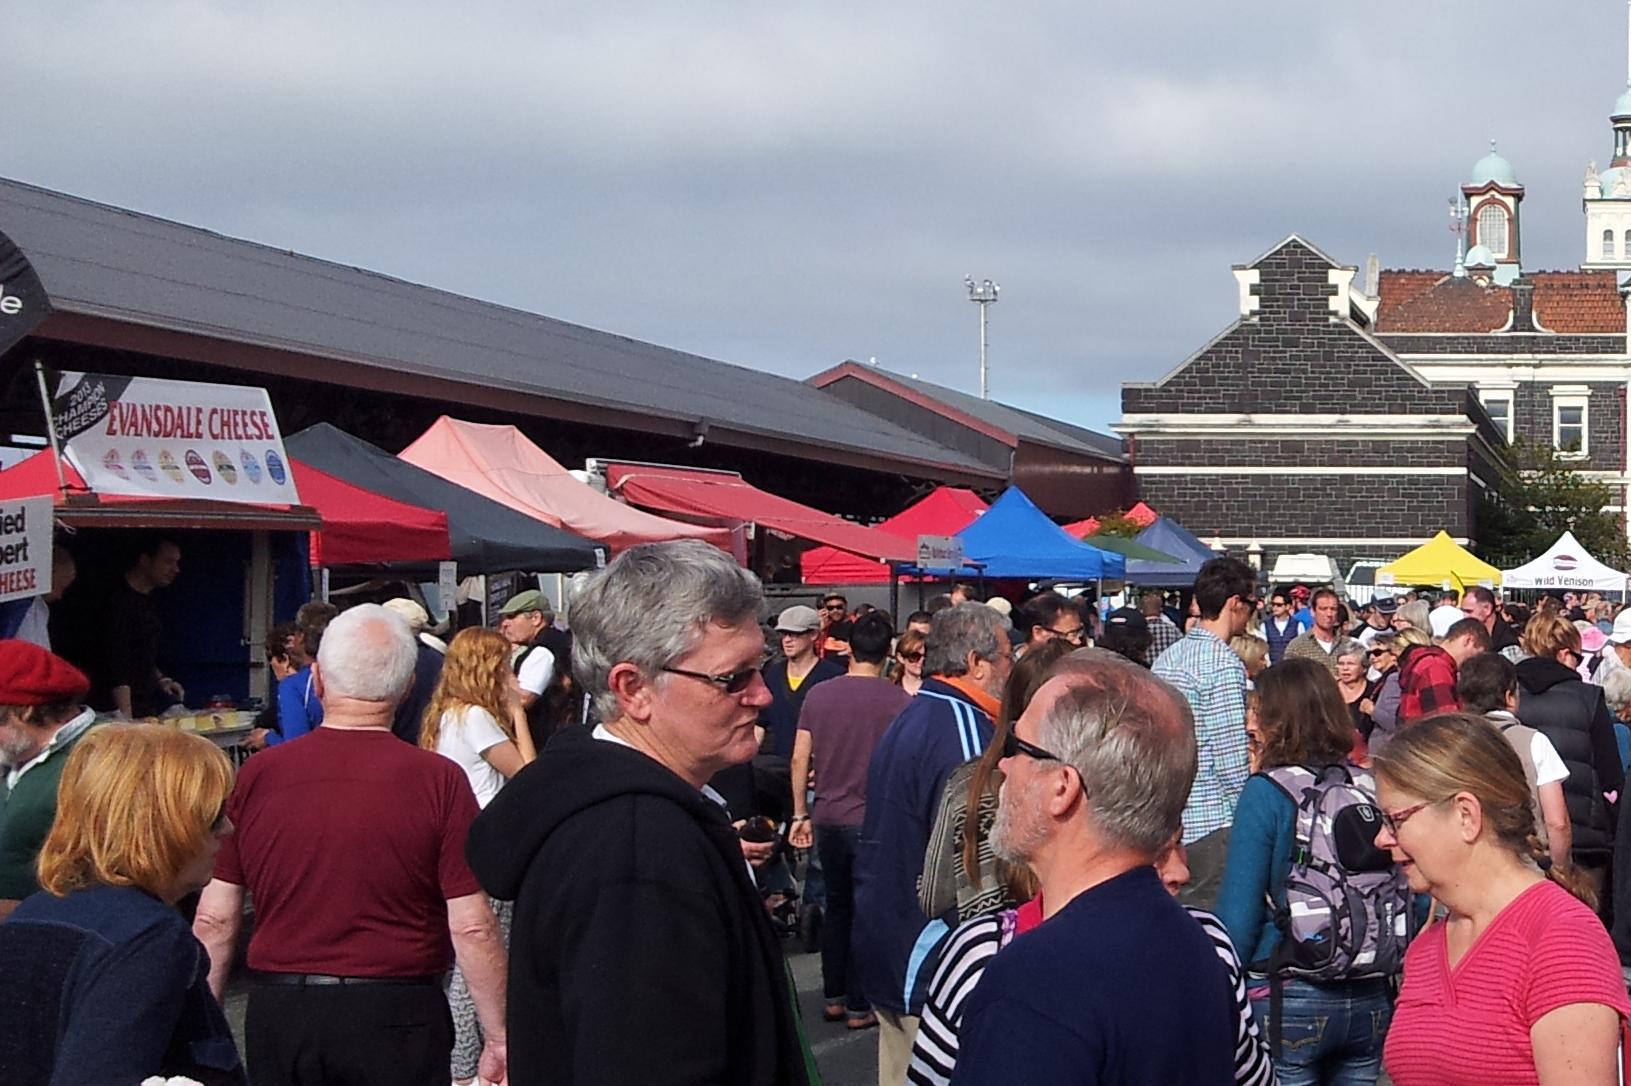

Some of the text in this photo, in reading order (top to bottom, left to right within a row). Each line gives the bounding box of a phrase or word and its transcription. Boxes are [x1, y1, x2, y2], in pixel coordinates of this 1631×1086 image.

[105, 400, 275, 440] EVANSDALE CHEESE
[1558, 575, 1594, 587] Venison
